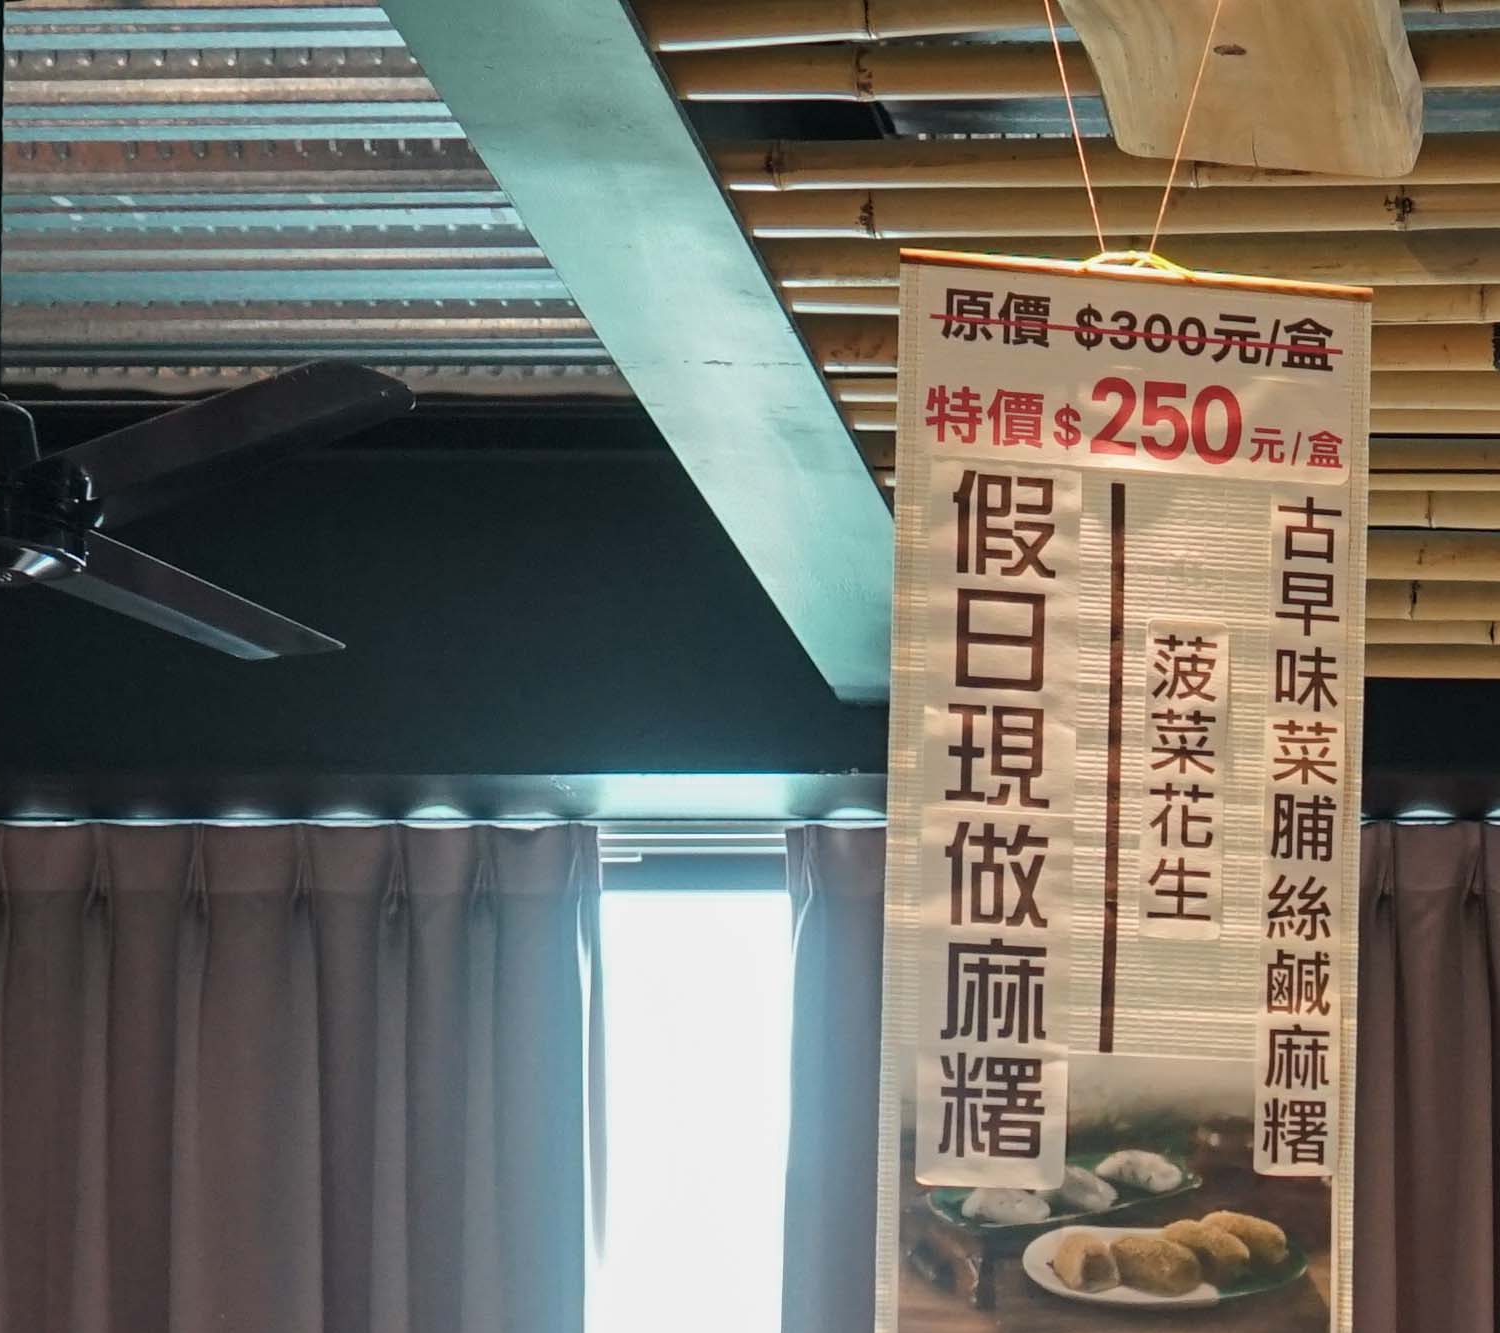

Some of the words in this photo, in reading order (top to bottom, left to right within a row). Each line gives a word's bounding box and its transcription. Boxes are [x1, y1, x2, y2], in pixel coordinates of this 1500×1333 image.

[941, 288, 1051, 348] 原價
[938, 468, 1057, 1161] 假日現做麻糬
[1147, 636, 1219, 924] 菠菜花生
[1262, 498, 1341, 1166] 古早味菜脯絲鹹麻糬
